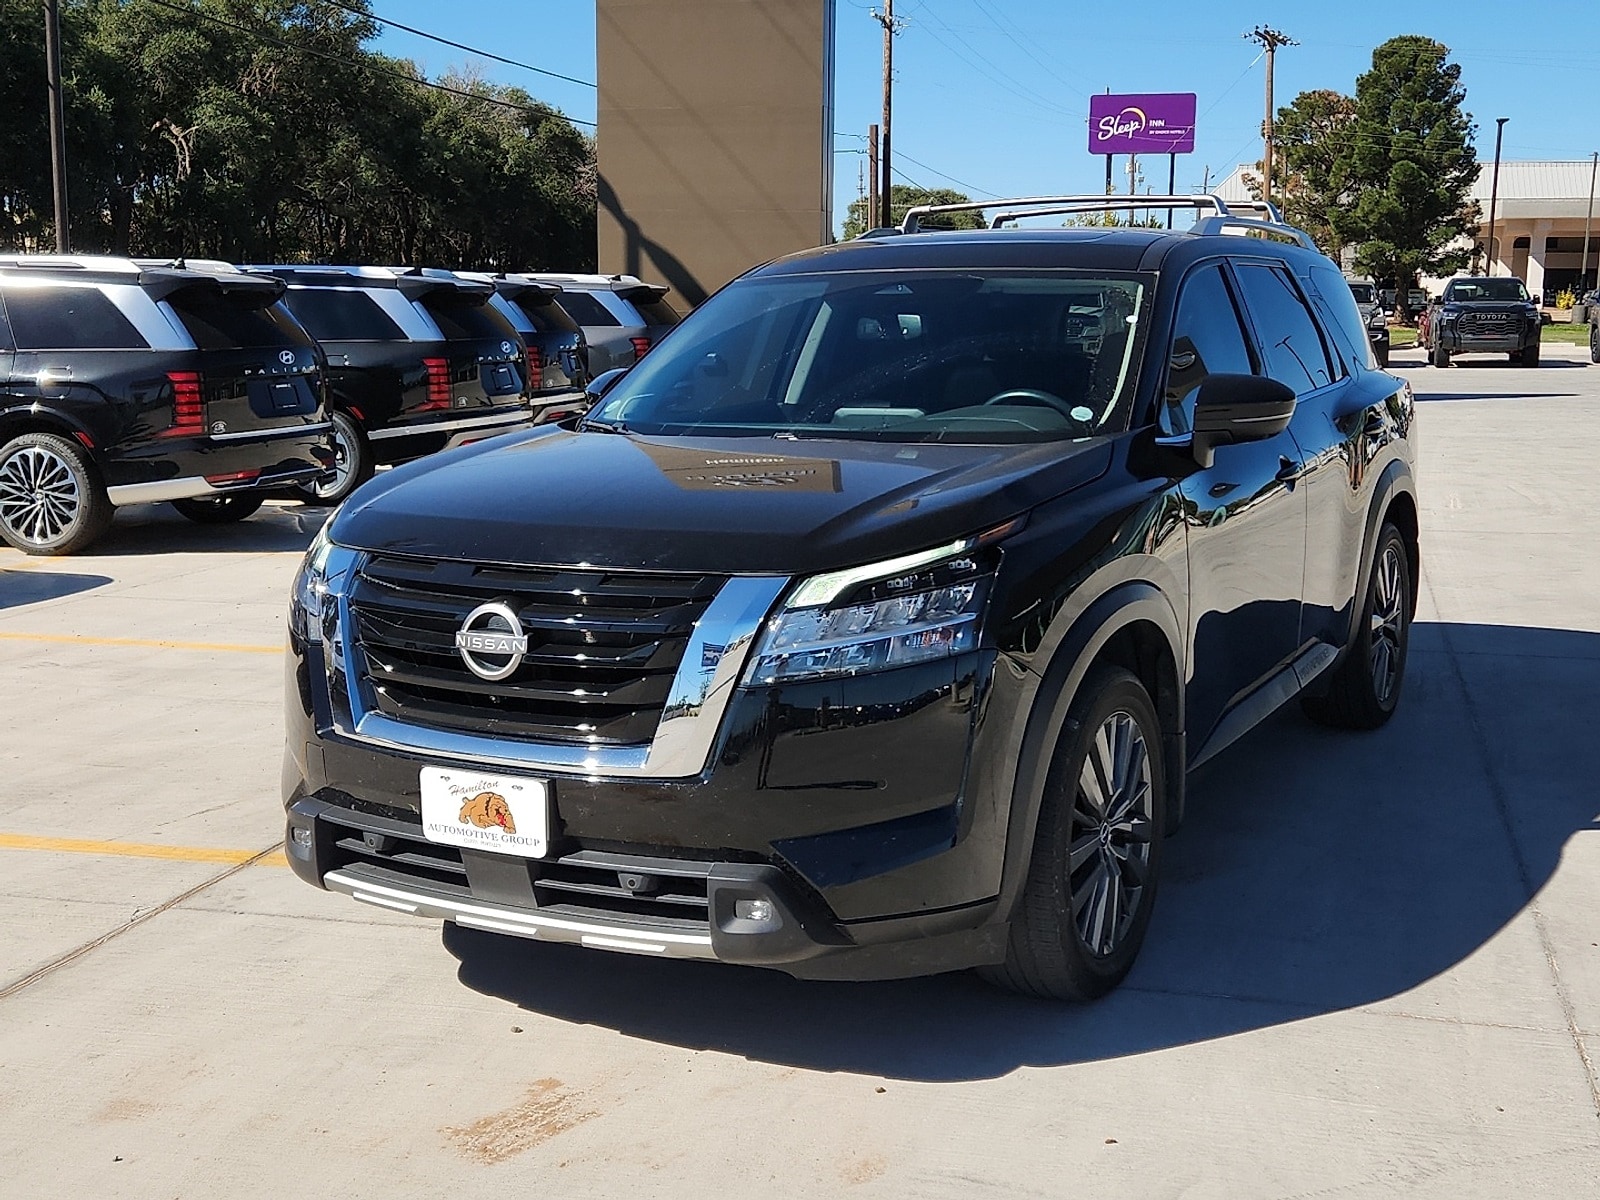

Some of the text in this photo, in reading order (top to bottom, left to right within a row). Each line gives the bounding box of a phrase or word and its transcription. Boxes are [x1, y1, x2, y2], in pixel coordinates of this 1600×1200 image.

[1097, 115, 1165, 140] Sleep INN
[456, 635, 526, 652] NISSAN
[448, 780, 499, 796] Hamilton
[428, 823, 499, 842] AUTOMOTIVE
[501, 834, 541, 847] GROUP
